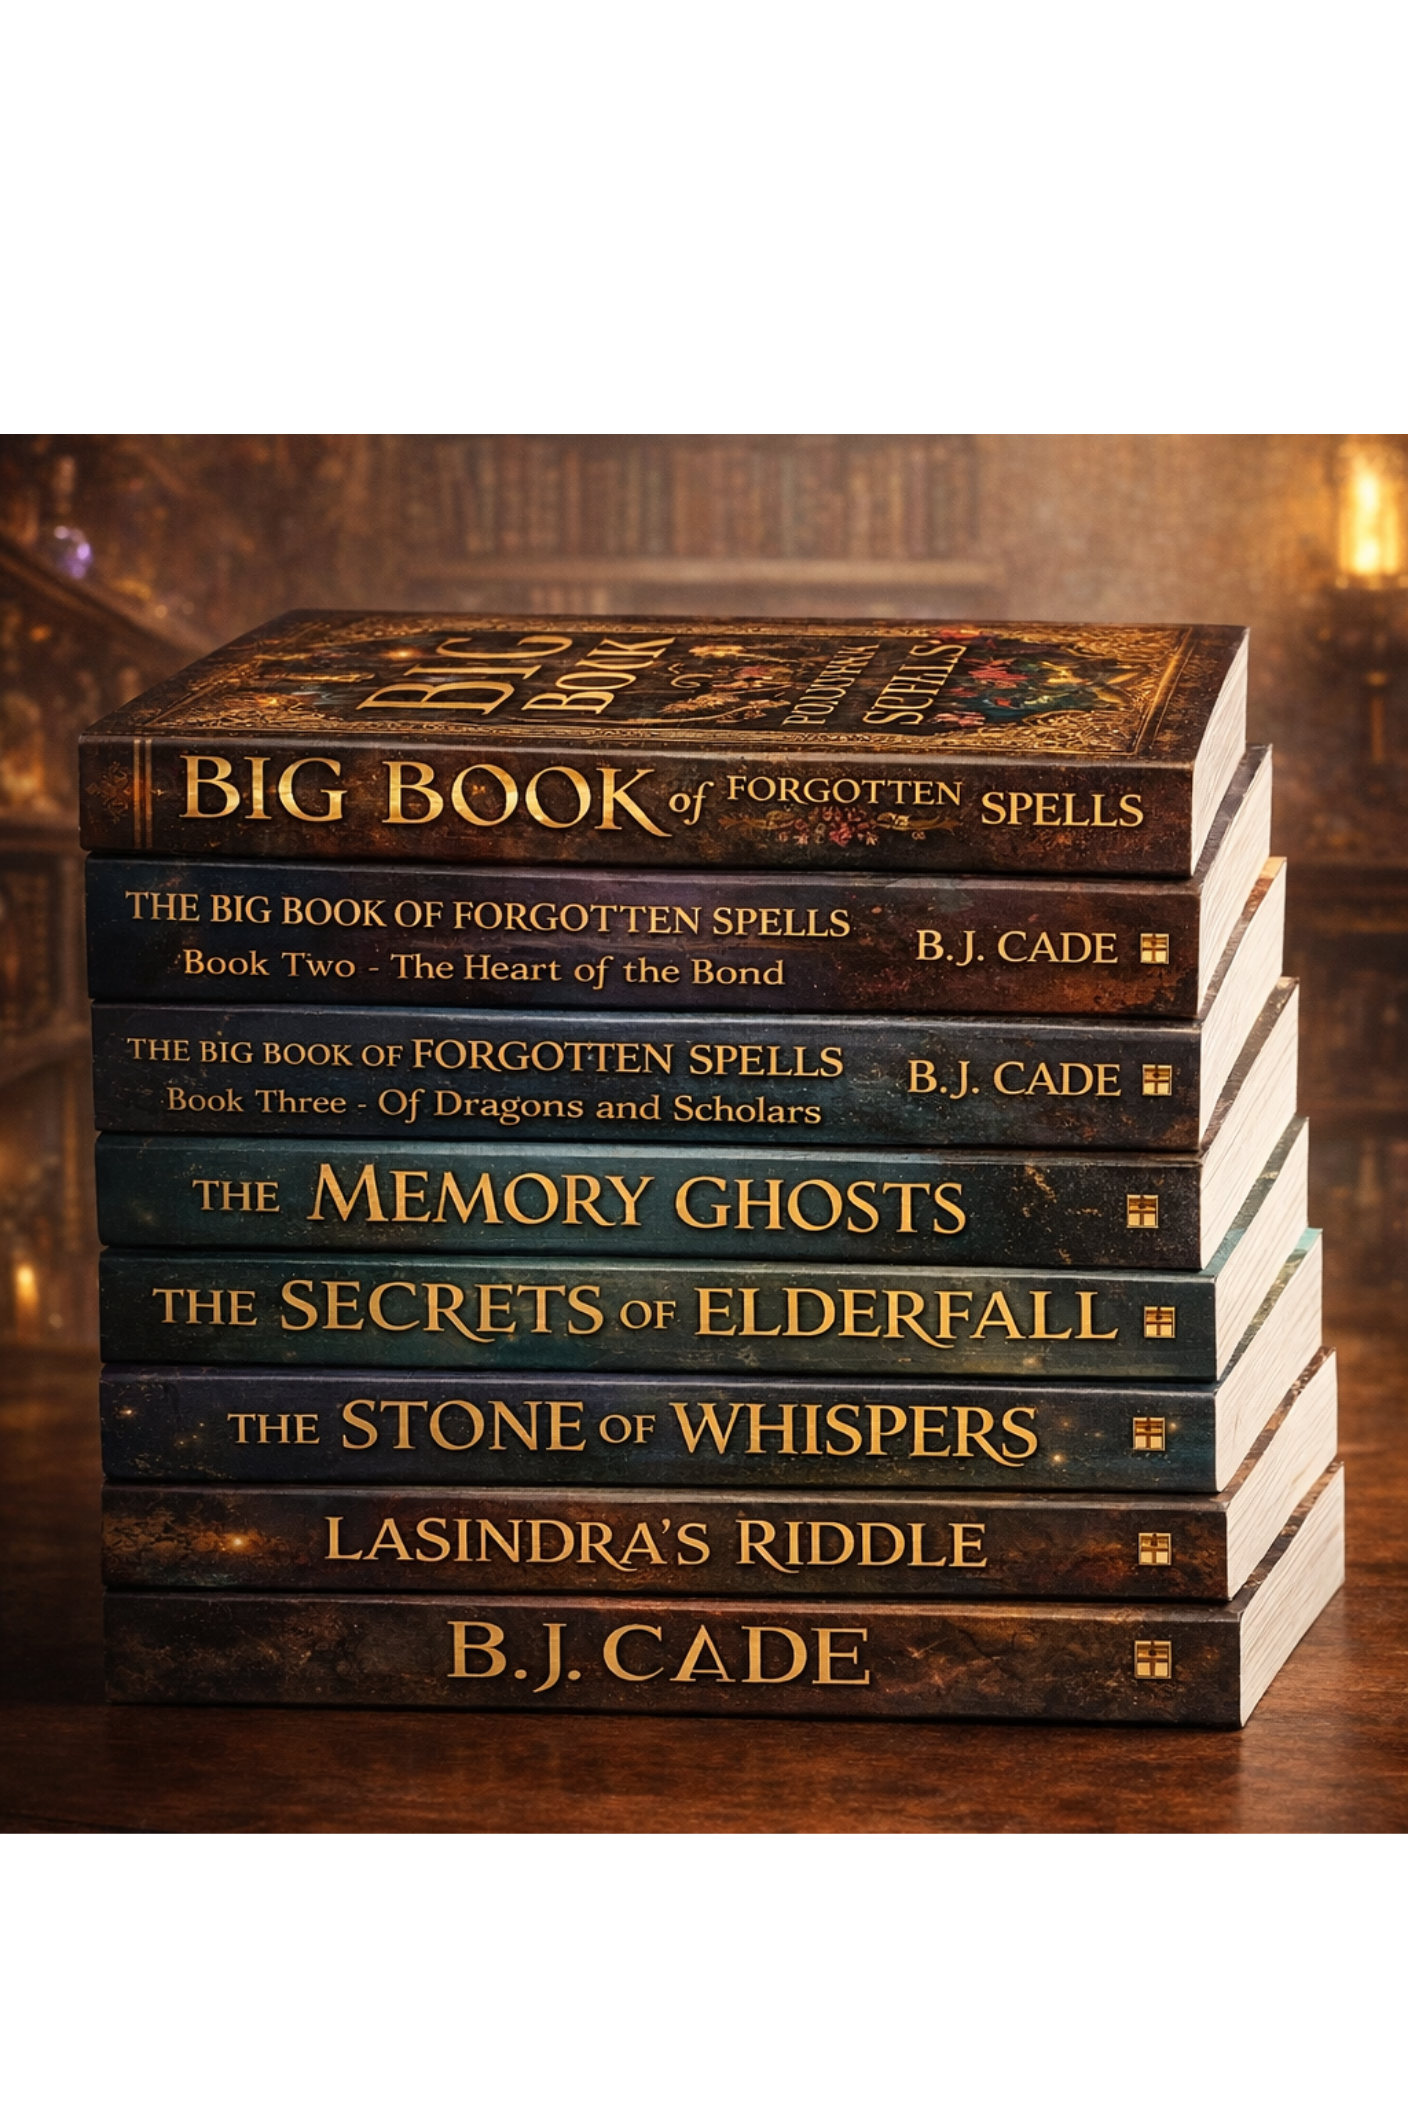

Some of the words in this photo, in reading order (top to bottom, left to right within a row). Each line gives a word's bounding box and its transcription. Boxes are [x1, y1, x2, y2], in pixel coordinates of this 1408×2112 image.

[355, 634, 574, 716] BIG
[178, 755, 347, 823] BIG
[382, 761, 673, 837] BOOK
[668, 780, 714, 827] of
[726, 775, 963, 806] FORGOTTEN
[981, 791, 1144, 827] SPELLS
[124, 890, 201, 922] THE
[211, 894, 271, 923] BIG
[283, 897, 386, 927] BOOK
[394, 900, 444, 928] OF
[454, 901, 702, 934] FORGOTTEN
[713, 906, 850, 937] SPELLS
[184, 949, 268, 975] Book
[281, 952, 355, 977] Two
[390, 952, 455, 980] The
[463, 954, 561, 982] Heart
[574, 955, 614, 990] of
[623, 957, 680, 983] the
[691, 959, 783, 985] Bond
[916, 929, 984, 967] B.J.
[997, 930, 1118, 963] CADE
[126, 1037, 191, 1062] THE
[201, 1041, 252, 1063] BIG
[264, 1043, 353, 1066] BOOK
[360, 1045, 404, 1067] OF
[413, 1039, 674, 1074] FORGOTTEN
[689, 1044, 843, 1077] SPELLS
[908, 1059, 979, 1099] B.J.
[993, 1061, 1121, 1097] CADE
[169, 1087, 244, 1112] Book
[254, 1088, 348, 1114] Three
[378, 1089, 425, 1124] Of
[437, 1091, 584, 1125] Dragons
[596, 1095, 659, 1120] and
[674, 1095, 821, 1124] Scholars
[193, 1180, 280, 1212] THE
[307, 1163, 655, 1226] MEMORY
[675, 1176, 966, 1234] GHOSTS
[152, 1289, 257, 1325] THE
[281, 1279, 603, 1343] SECRETS
[620, 1300, 676, 1329] OF
[694, 1287, 1119, 1349] ELDERFALL
[227, 1413, 320, 1444] THE
[342, 1399, 586, 1451] STONE
[599, 1414, 656, 1443] OF
[669, 1402, 1038, 1467] WHISPERS
[326, 1516, 711, 1573] LASINDRA’S
[735, 1519, 988, 1574] RIDDLE
[447, 1621, 581, 1693] B.J.
[603, 1623, 870, 1685] CADE
